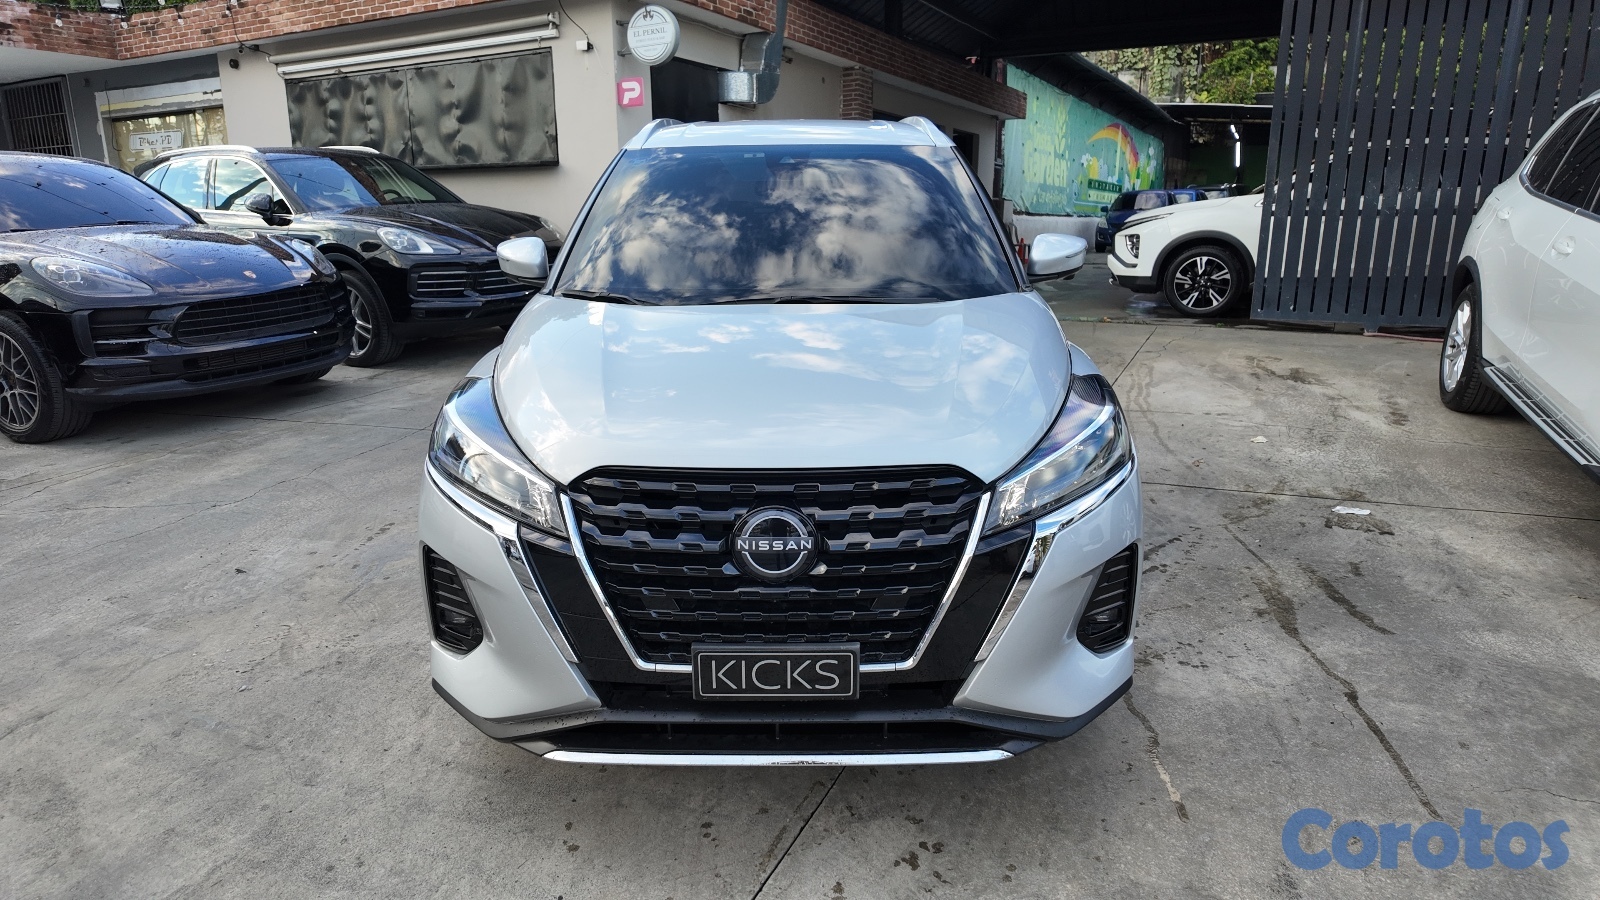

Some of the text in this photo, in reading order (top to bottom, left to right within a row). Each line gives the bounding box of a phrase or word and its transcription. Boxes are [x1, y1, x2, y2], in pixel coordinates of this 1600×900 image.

[633, 26, 668, 38] EL PERNIL
[737, 540, 812, 551] NISSAN
[711, 659, 840, 690] KICKS
